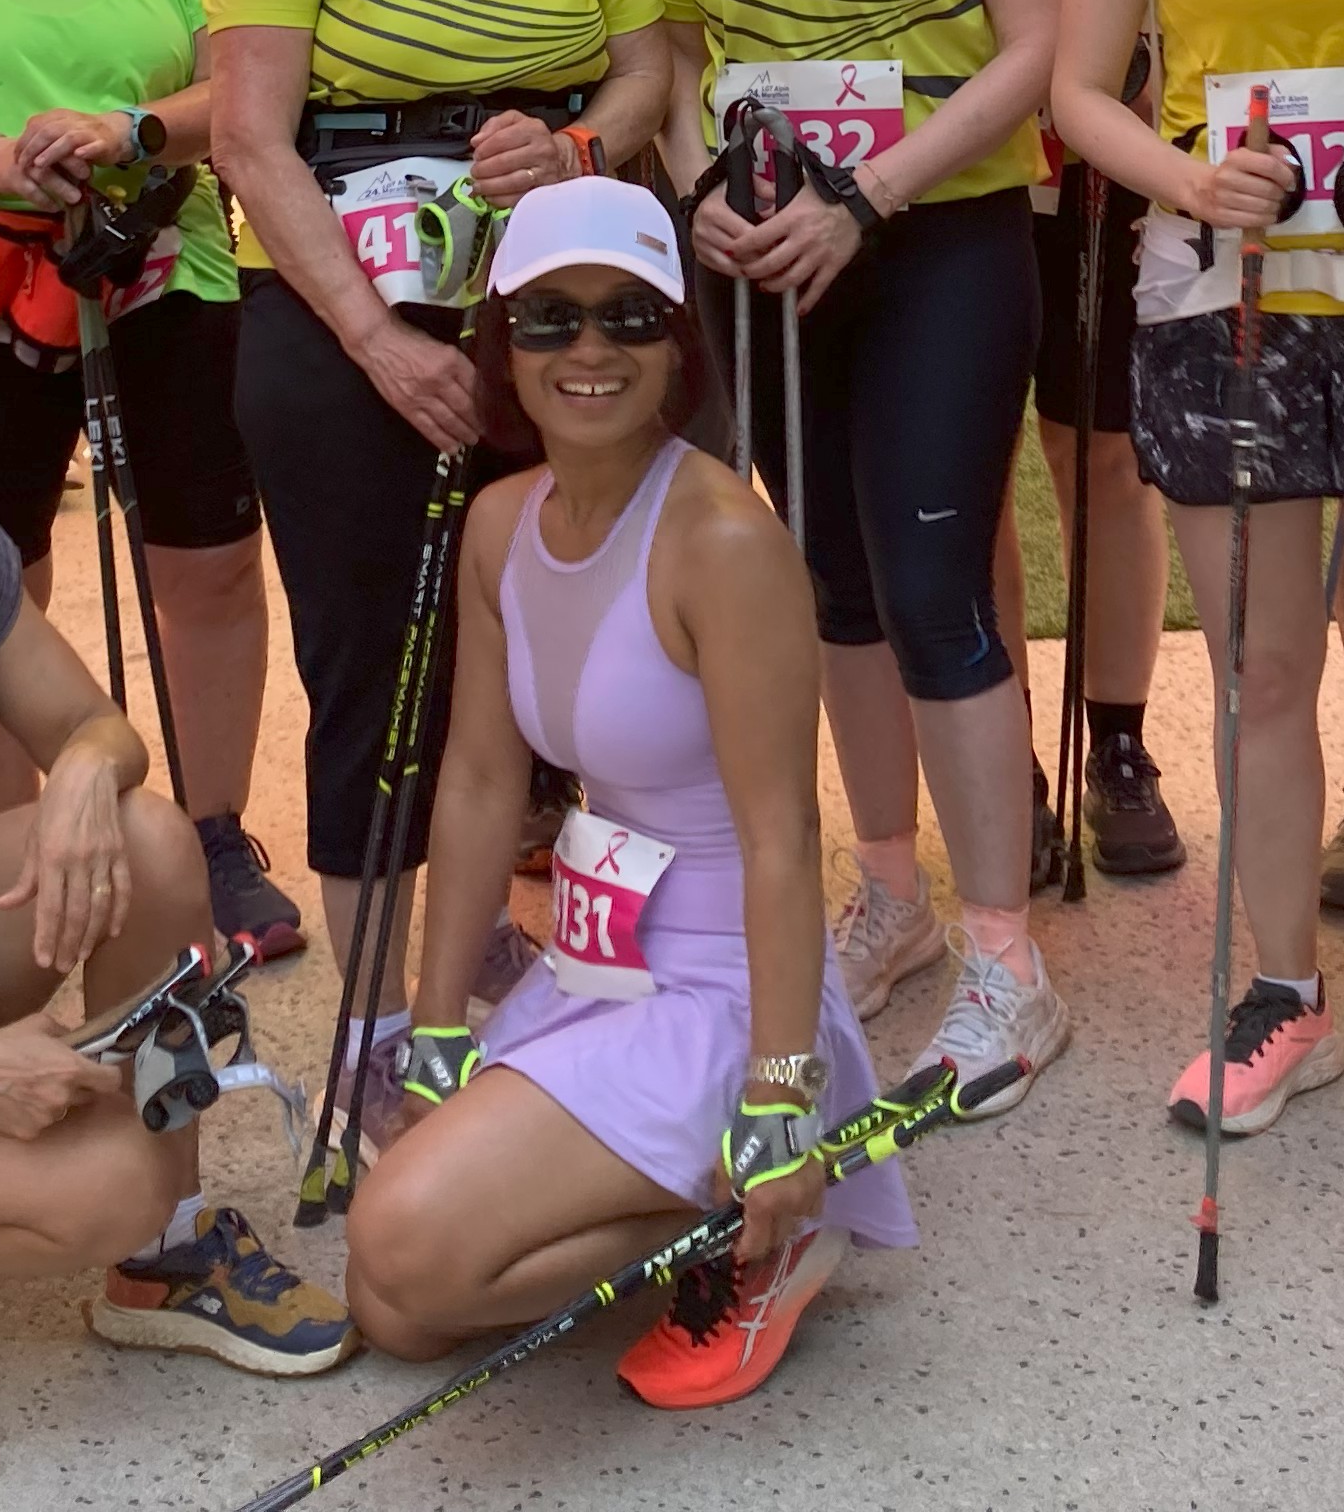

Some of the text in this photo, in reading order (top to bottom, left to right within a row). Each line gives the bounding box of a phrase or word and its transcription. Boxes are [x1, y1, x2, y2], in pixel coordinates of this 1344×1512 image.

[753, 119, 875, 173] 32
[358, 212, 421, 268] 41
[86, 398, 105, 472] LEKI
[103, 394, 126, 466] LEKI
[643, 1223, 709, 1280] LEKI
